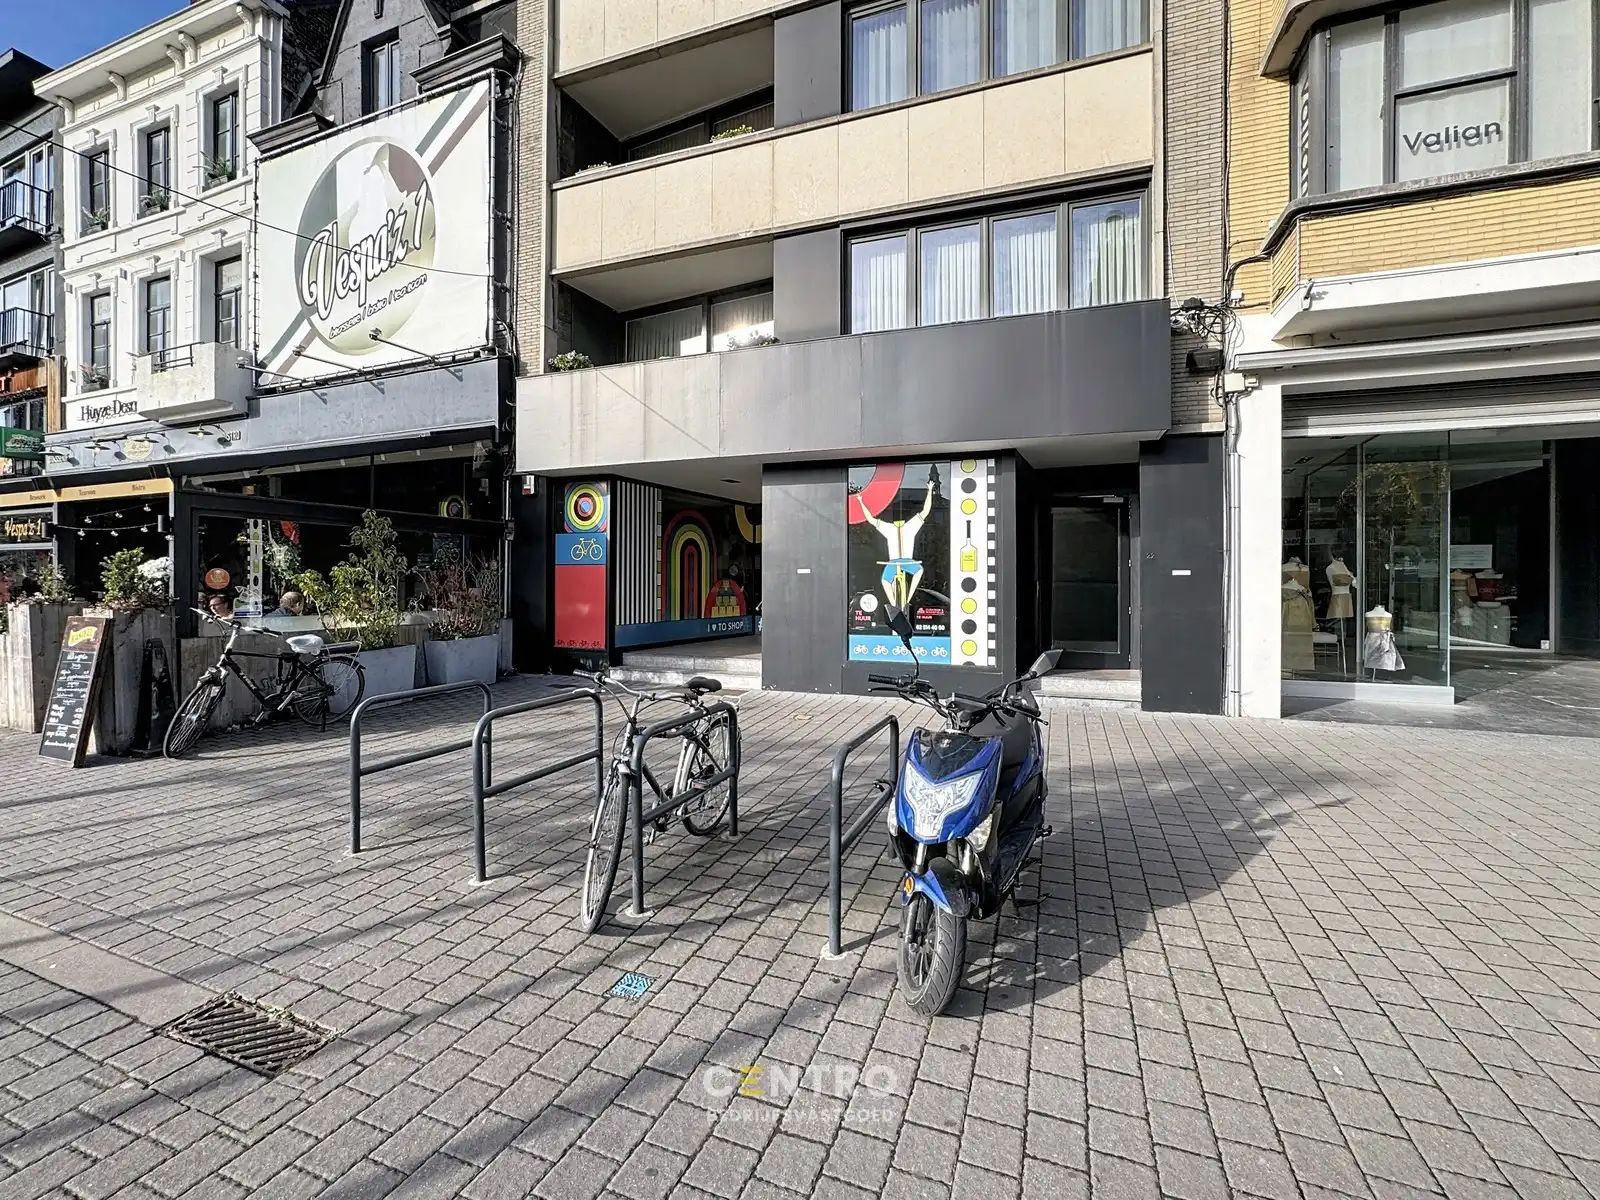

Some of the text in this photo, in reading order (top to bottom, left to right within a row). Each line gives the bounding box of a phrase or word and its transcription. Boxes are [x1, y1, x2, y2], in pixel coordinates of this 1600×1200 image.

[1402, 121, 1501, 152] Valian
[413, 179, 429, 250] 1
[367, 298, 387, 317] bistro
[718, 622, 727, 632] TO
[727, 621, 744, 631] SHOP
